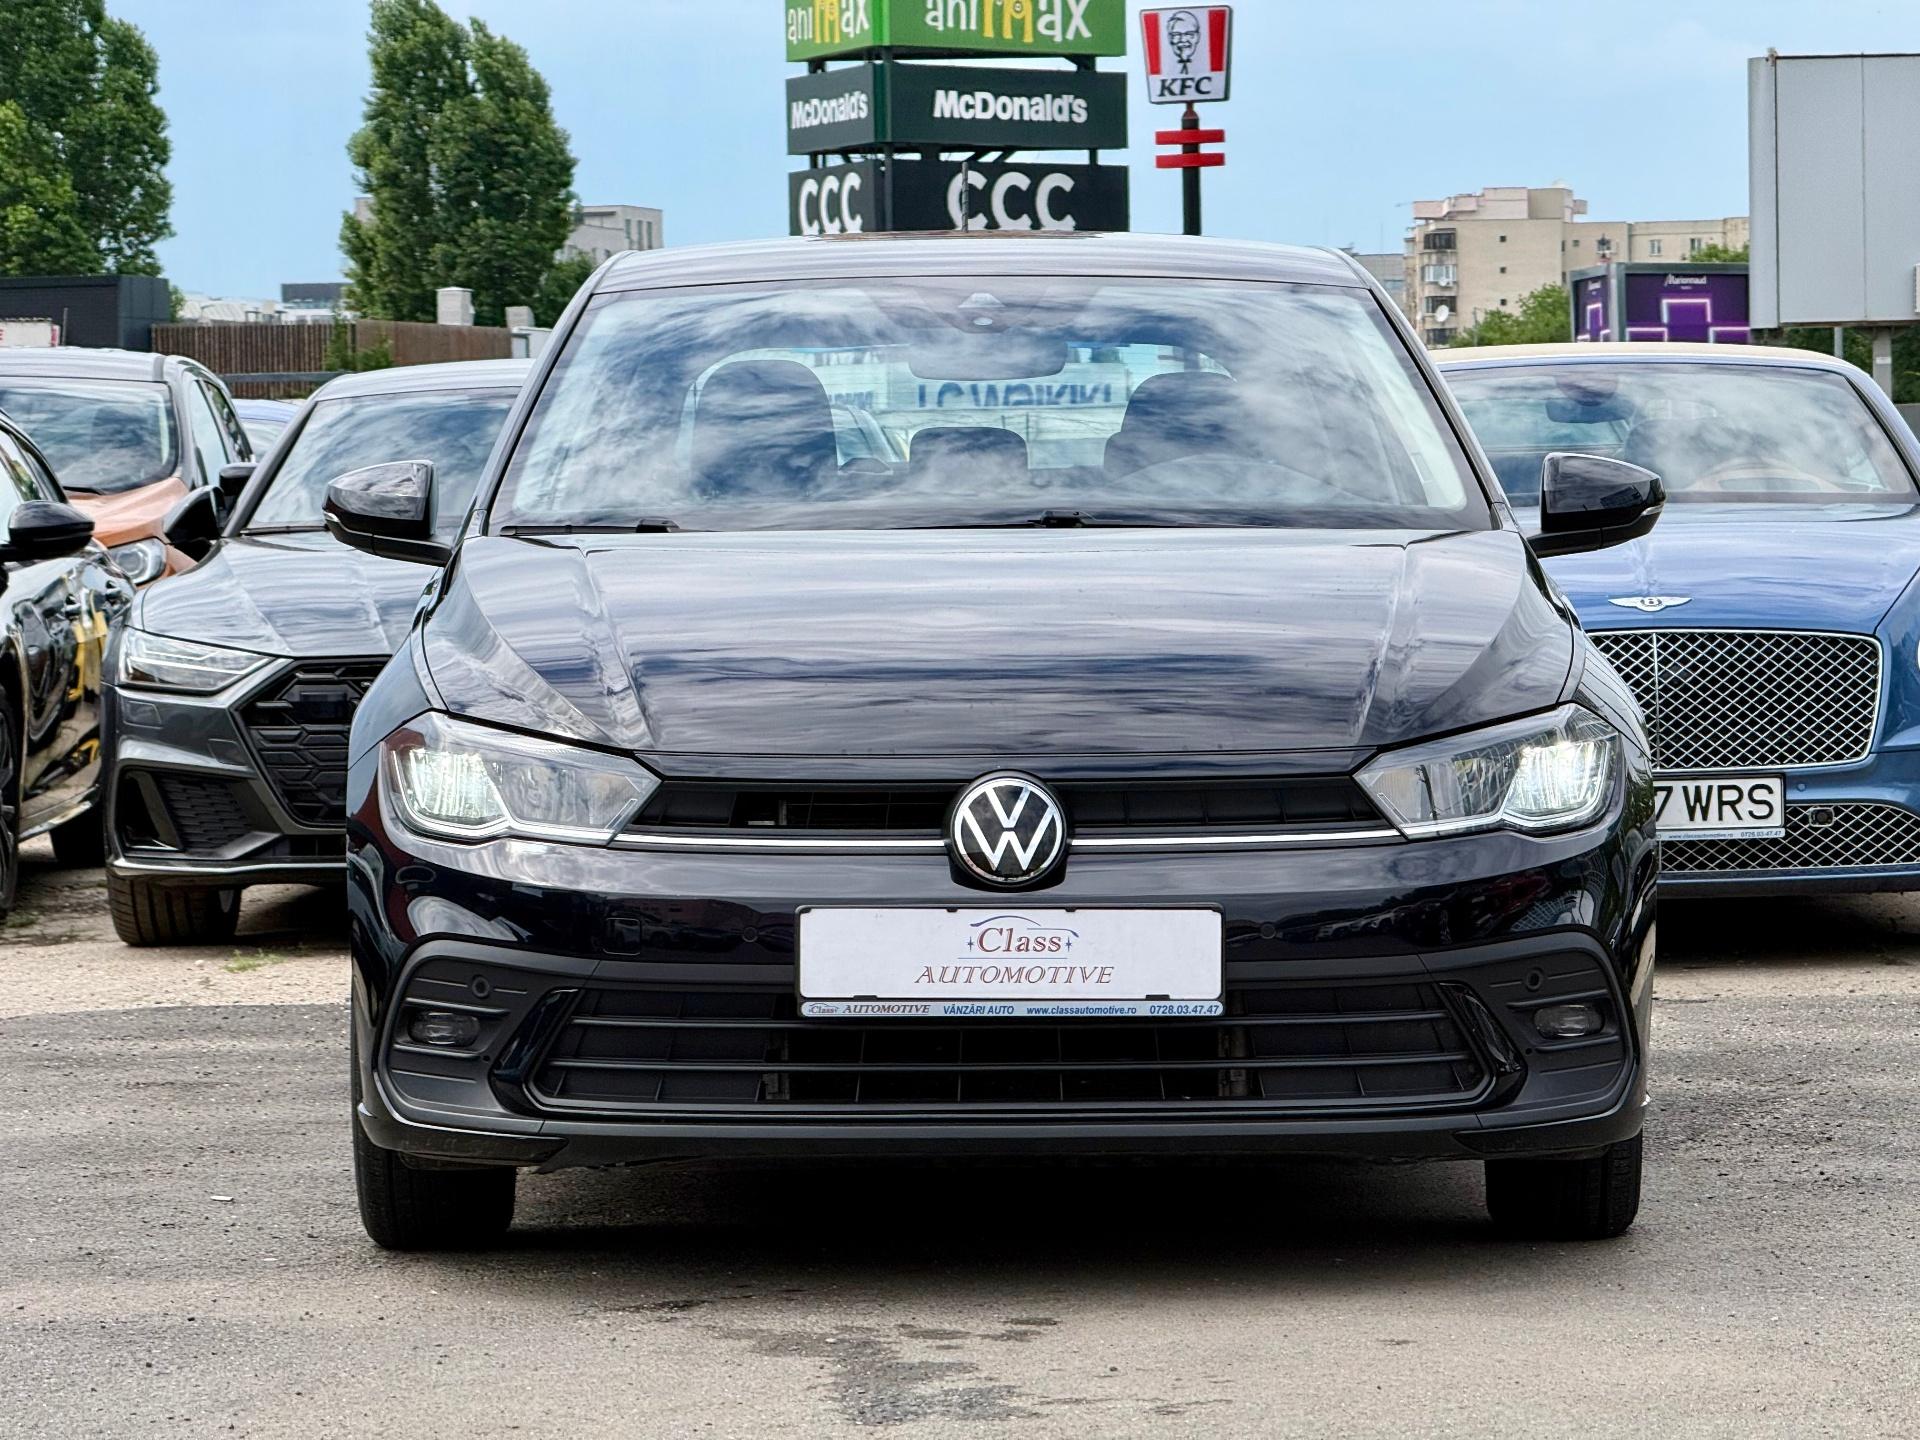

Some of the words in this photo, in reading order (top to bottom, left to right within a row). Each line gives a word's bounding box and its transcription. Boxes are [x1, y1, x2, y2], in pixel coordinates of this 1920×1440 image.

[1158, 76, 1213, 97] KFC
[791, 91, 868, 129] McDonald's
[933, 90, 1088, 123] McDonald's
[800, 172, 863, 234] CCC
[947, 170, 1076, 231] CCC
[1682, 784, 1774, 821] WRS
[977, 927, 1062, 953] Class
[914, 965, 1115, 984] AUTOMOTIVE
[842, 1004, 931, 1014] AUTOMOTIVE
[987, 1005, 1014, 1015] AUTO
[1026, 1005, 1137, 1015] www.classautomotive.ro
[1150, 1005, 1220, 1015] 0728.03.47.47
